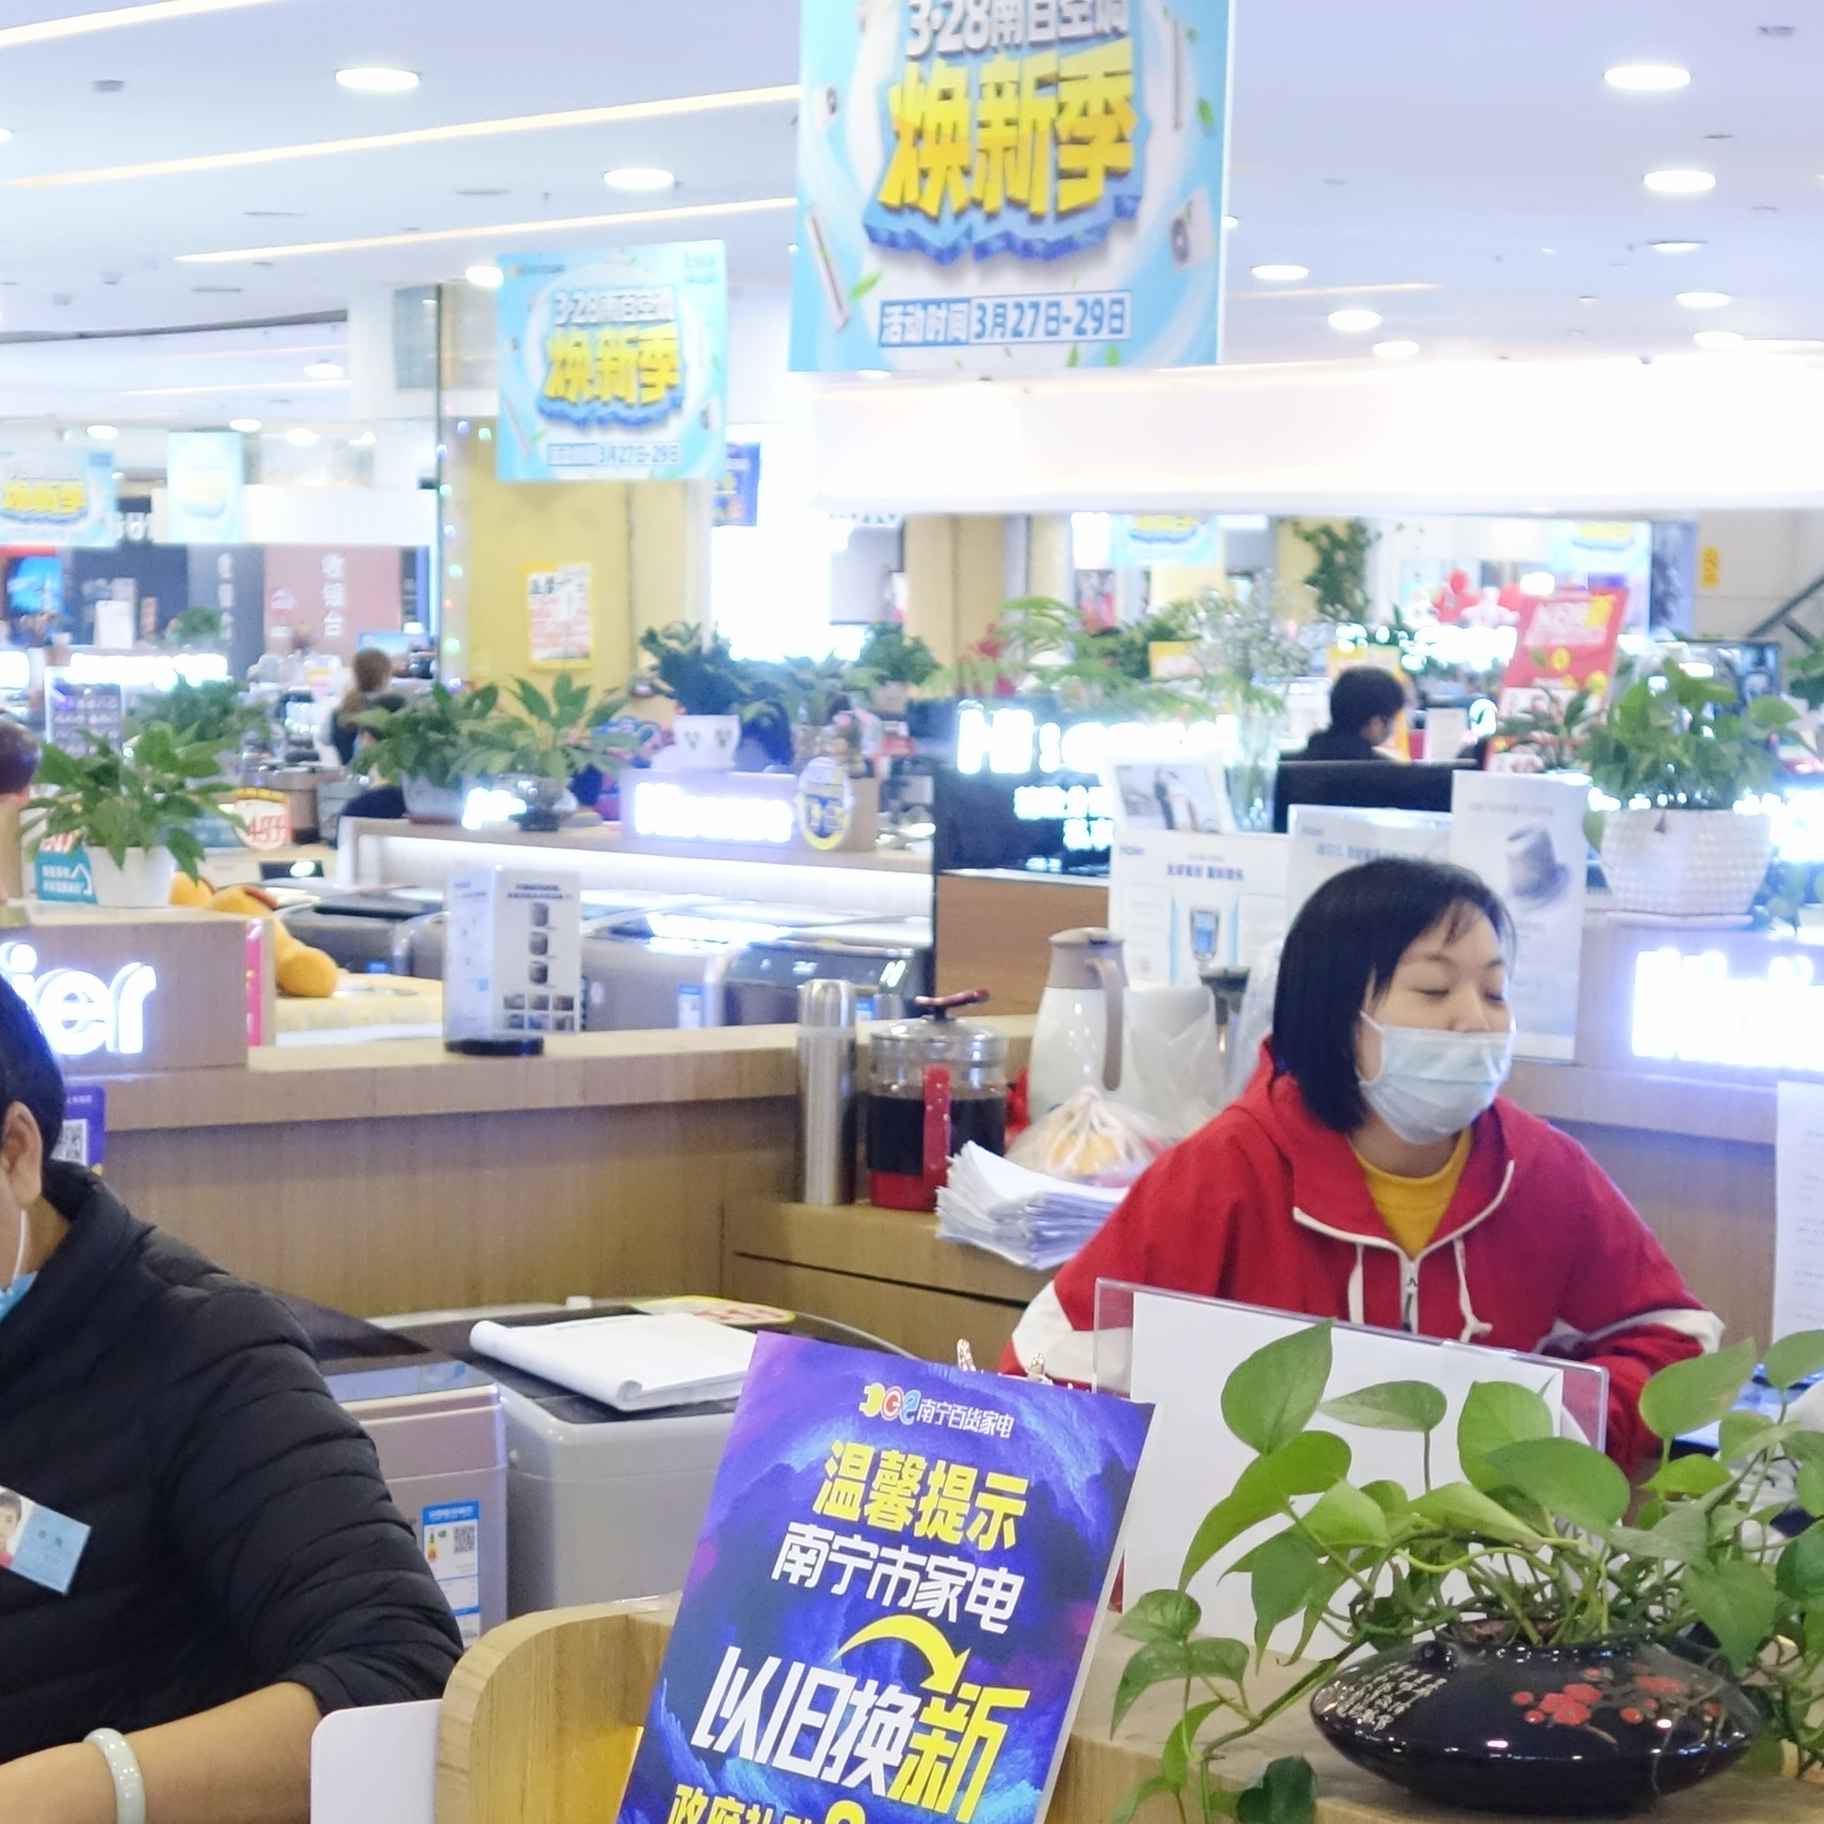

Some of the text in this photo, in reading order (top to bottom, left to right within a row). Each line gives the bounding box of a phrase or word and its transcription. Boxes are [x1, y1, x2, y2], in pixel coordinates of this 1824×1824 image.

[878, 39, 1138, 220] 焕新季
[974, 296, 1127, 340] 3月27日-29日
[916, 1395, 1015, 1440] 南宁百货家电
[812, 1439, 1033, 1552] 温馨提示
[771, 1521, 1026, 1636] 南宁市家电
[689, 1645, 1033, 1824] 以旧换新
